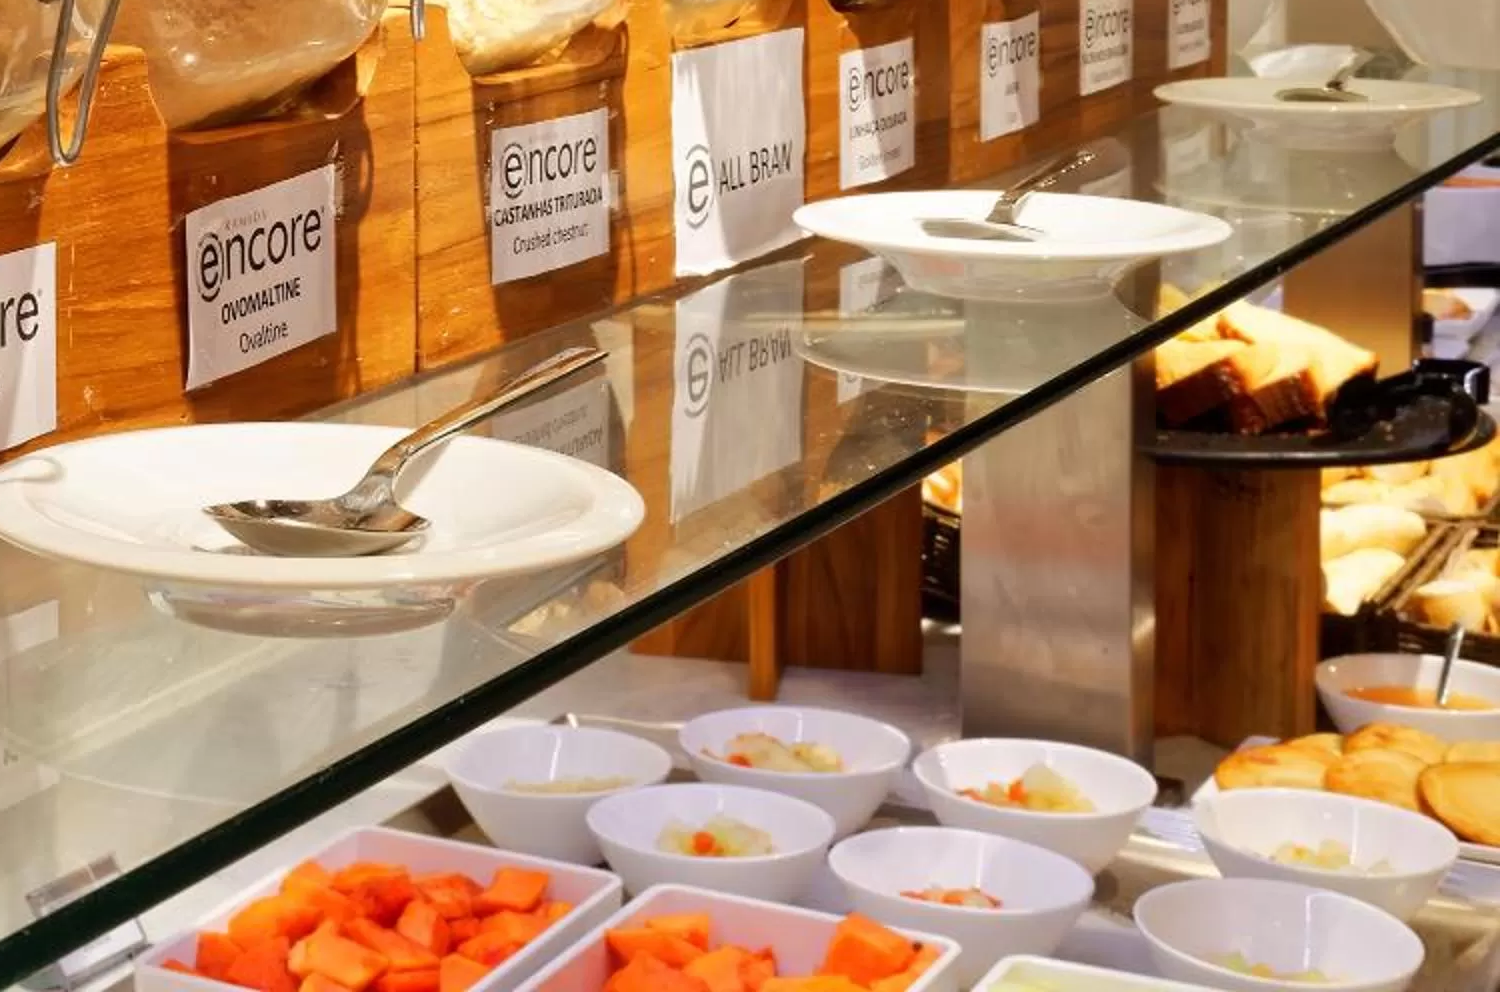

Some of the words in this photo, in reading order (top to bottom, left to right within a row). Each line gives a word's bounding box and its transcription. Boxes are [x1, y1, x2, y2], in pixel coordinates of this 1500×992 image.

[1085, 8, 1129, 49] encore
[988, 30, 1036, 78] encore
[849, 60, 909, 112] encore
[502, 136, 597, 199] encore
[718, 156, 745, 196] ALL
[749, 140, 793, 185] BRAN
[494, 197, 553, 227] CASTANHAS
[197, 209, 322, 302] encore
[513, 227, 551, 255] Crushed
[221, 277, 301, 324] OVOMALTINE
[239, 320, 289, 354] Ovaltine
